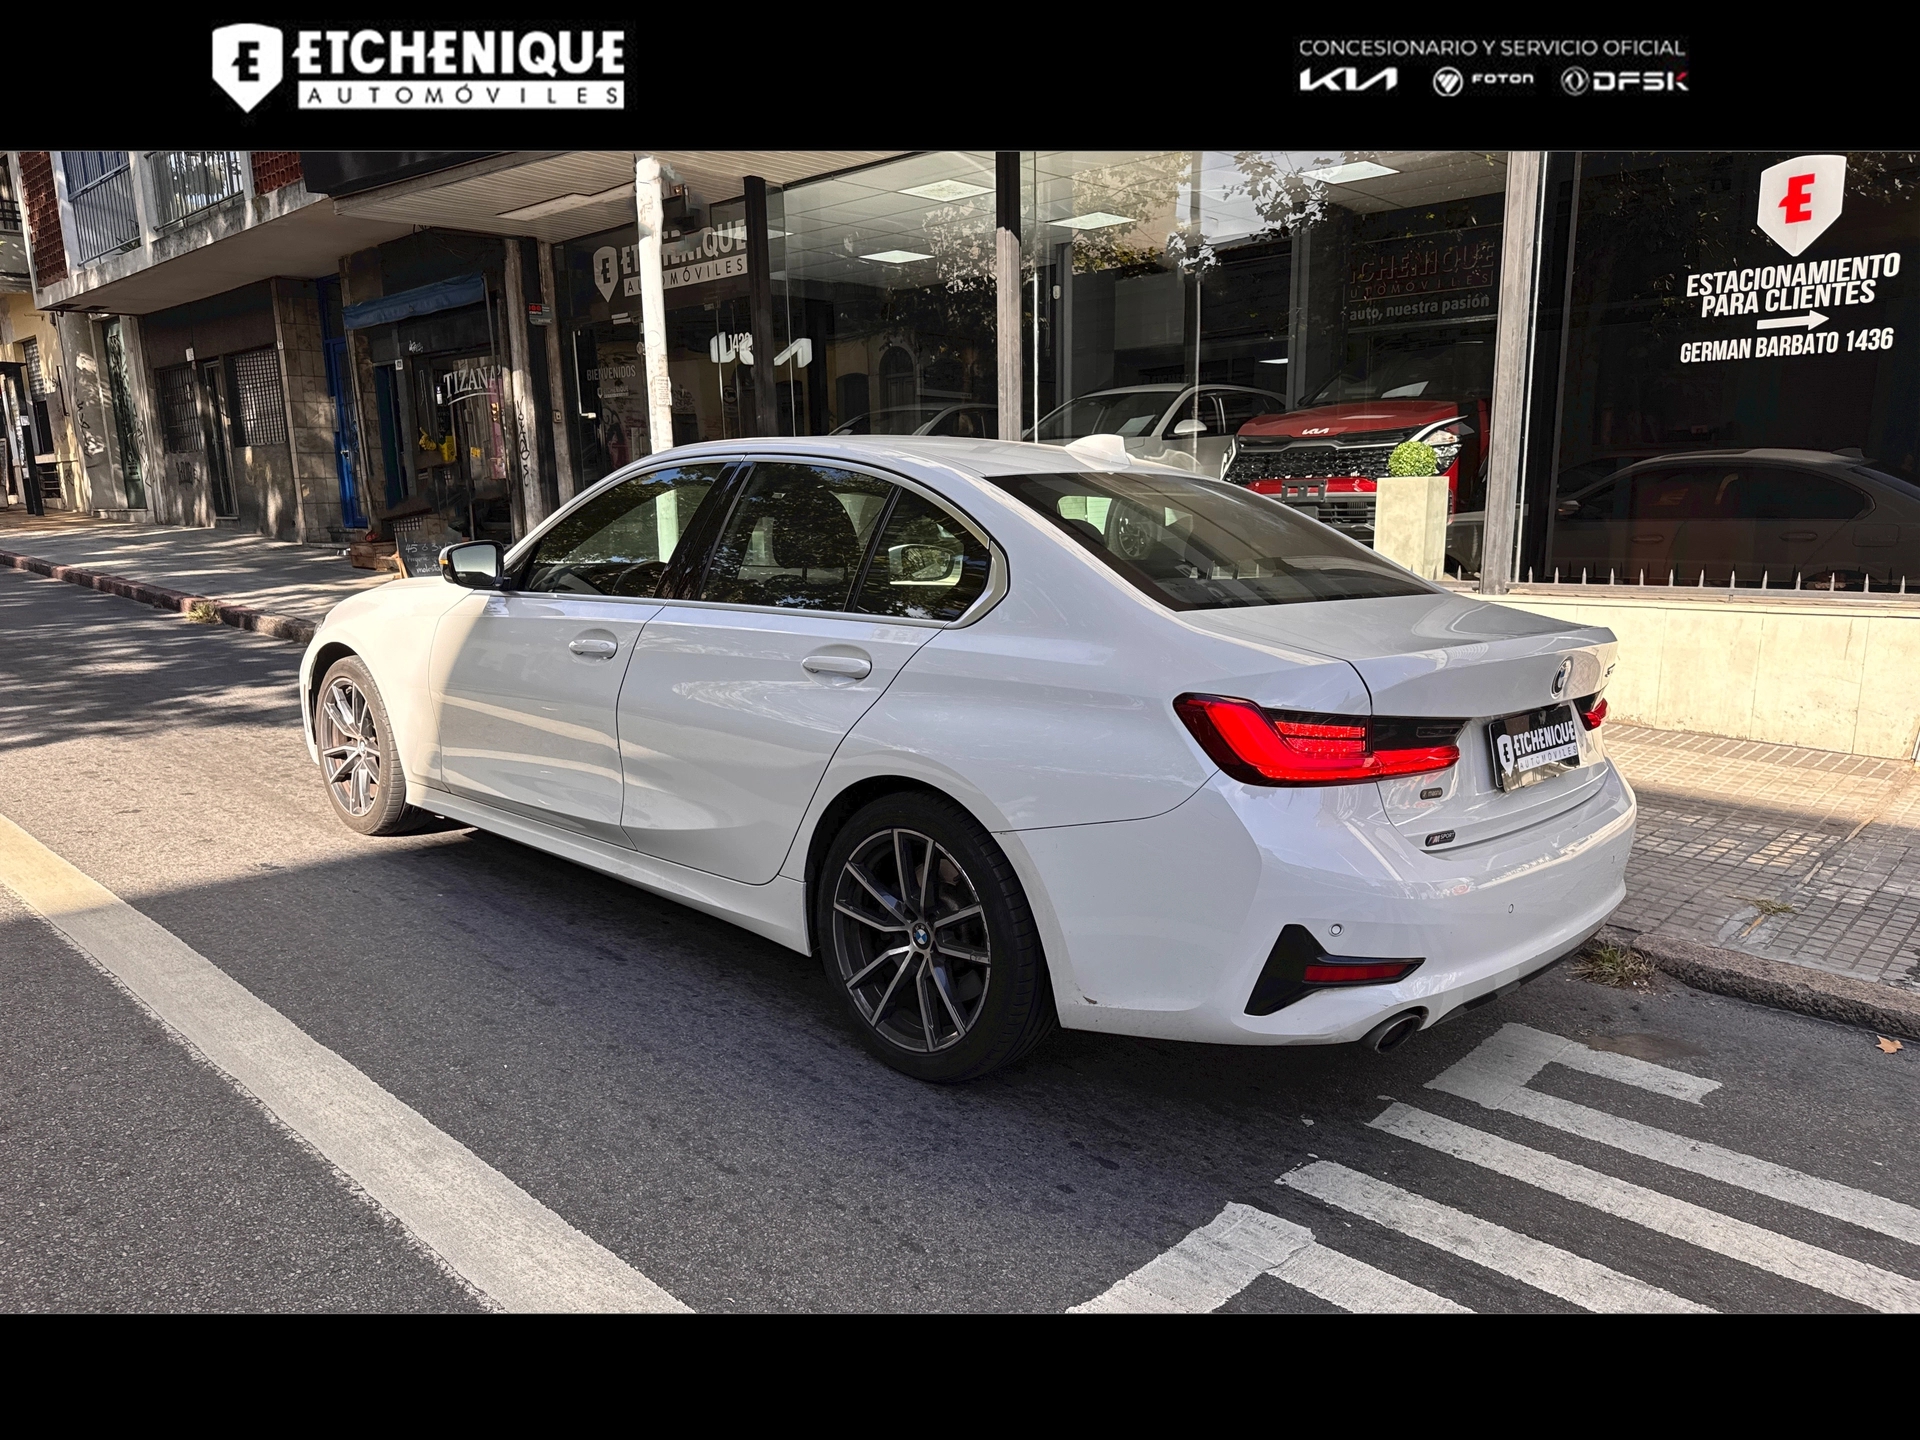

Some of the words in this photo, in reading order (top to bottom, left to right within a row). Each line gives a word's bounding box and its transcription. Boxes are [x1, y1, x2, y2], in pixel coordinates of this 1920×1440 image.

[627, 258, 743, 294] AMÓVILES
[1686, 252, 1901, 297] ESTACIONAMIENTO
[1350, 304, 1383, 321] auto,
[1386, 300, 1439, 317] nuestra
[1441, 293, 1490, 315] pasión
[1701, 291, 1759, 318] PARA
[1765, 279, 1877, 312] CLIENTES
[1680, 338, 1752, 363] GERMAN
[1755, 331, 1839, 358] BARBATO
[1846, 327, 1894, 352] 1436
[586, 365, 636, 381] BIENVENIDOS
[1513, 720, 1576, 756] ETCHENIQUE
